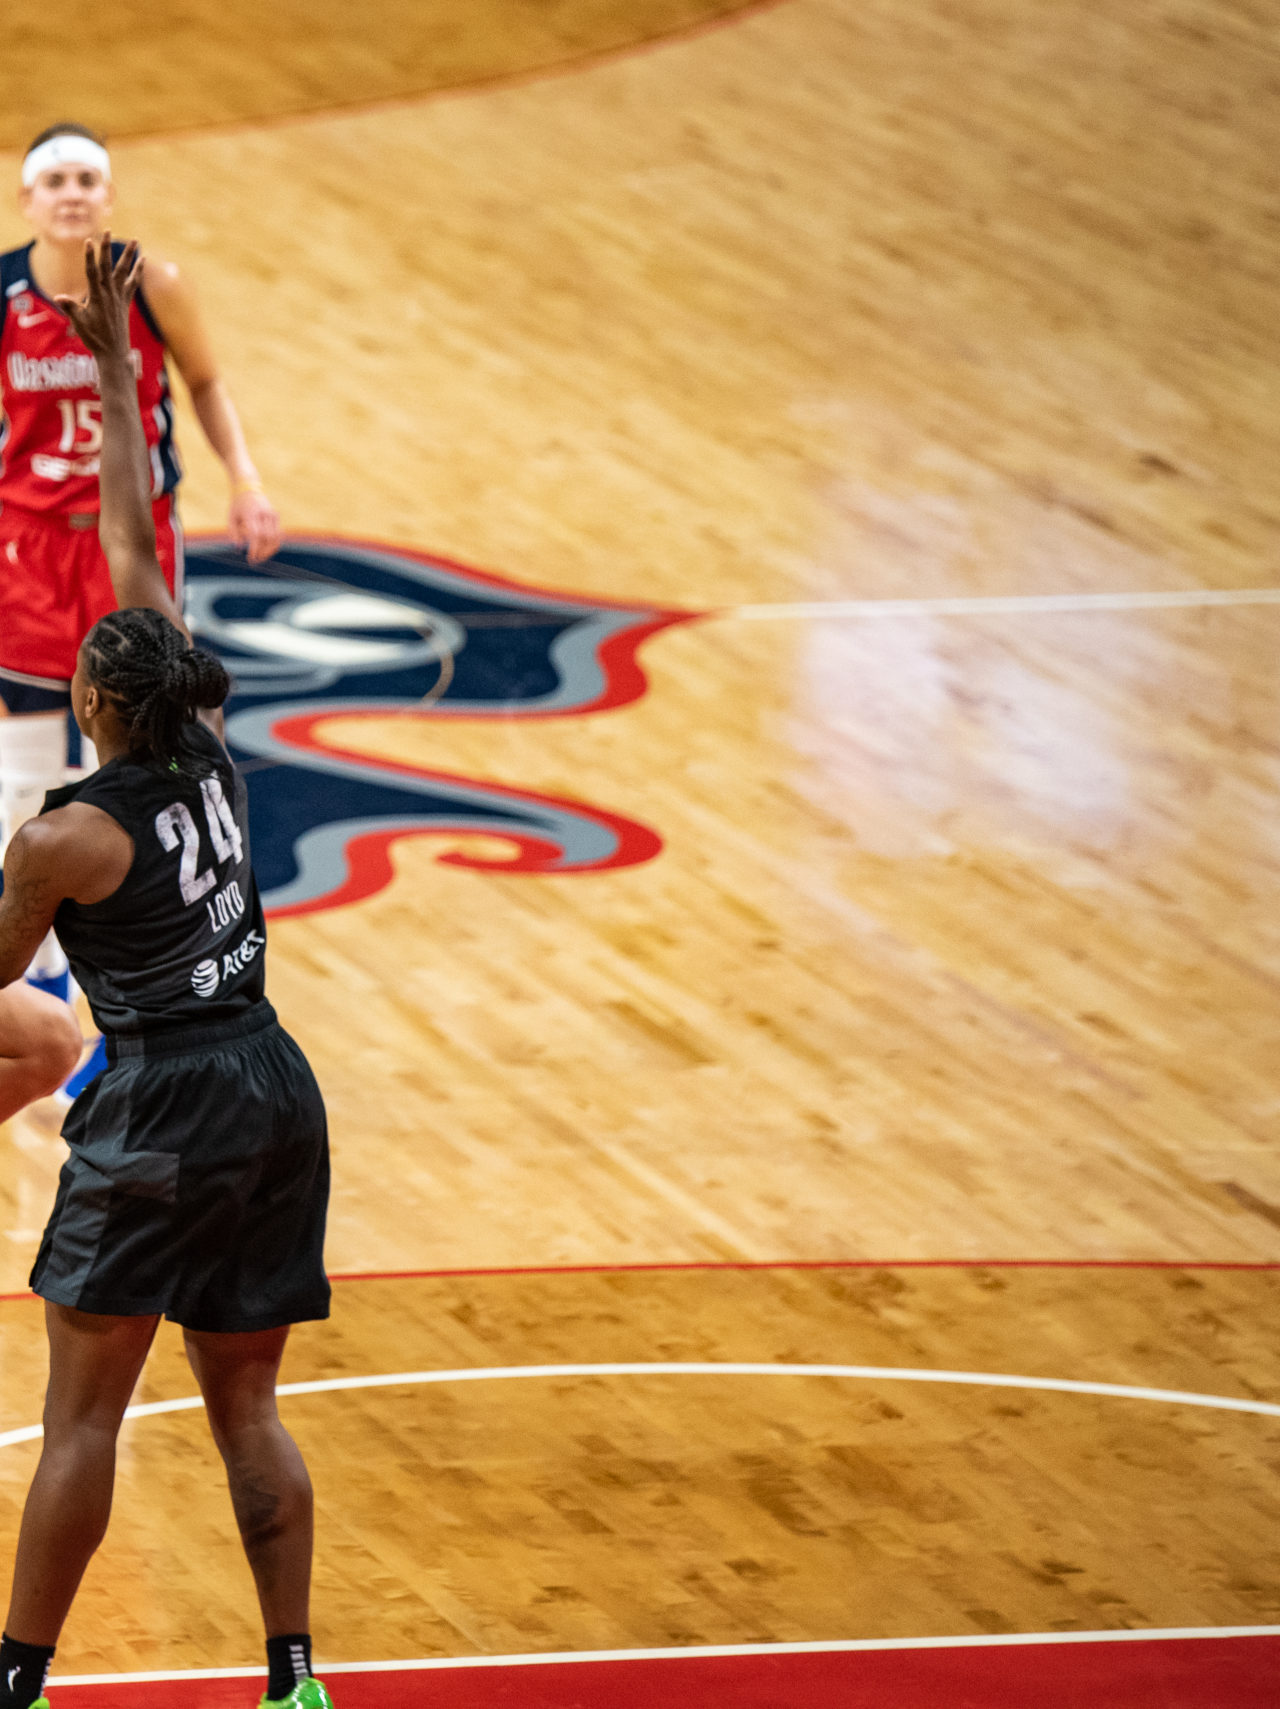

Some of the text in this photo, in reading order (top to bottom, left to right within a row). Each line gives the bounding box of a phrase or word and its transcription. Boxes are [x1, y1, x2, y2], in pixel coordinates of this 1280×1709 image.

[56, 398, 103, 453] 15
[155, 769, 244, 907] 24
[206, 880, 246, 934] LOYD
[222, 928, 266, 981] AT&T
